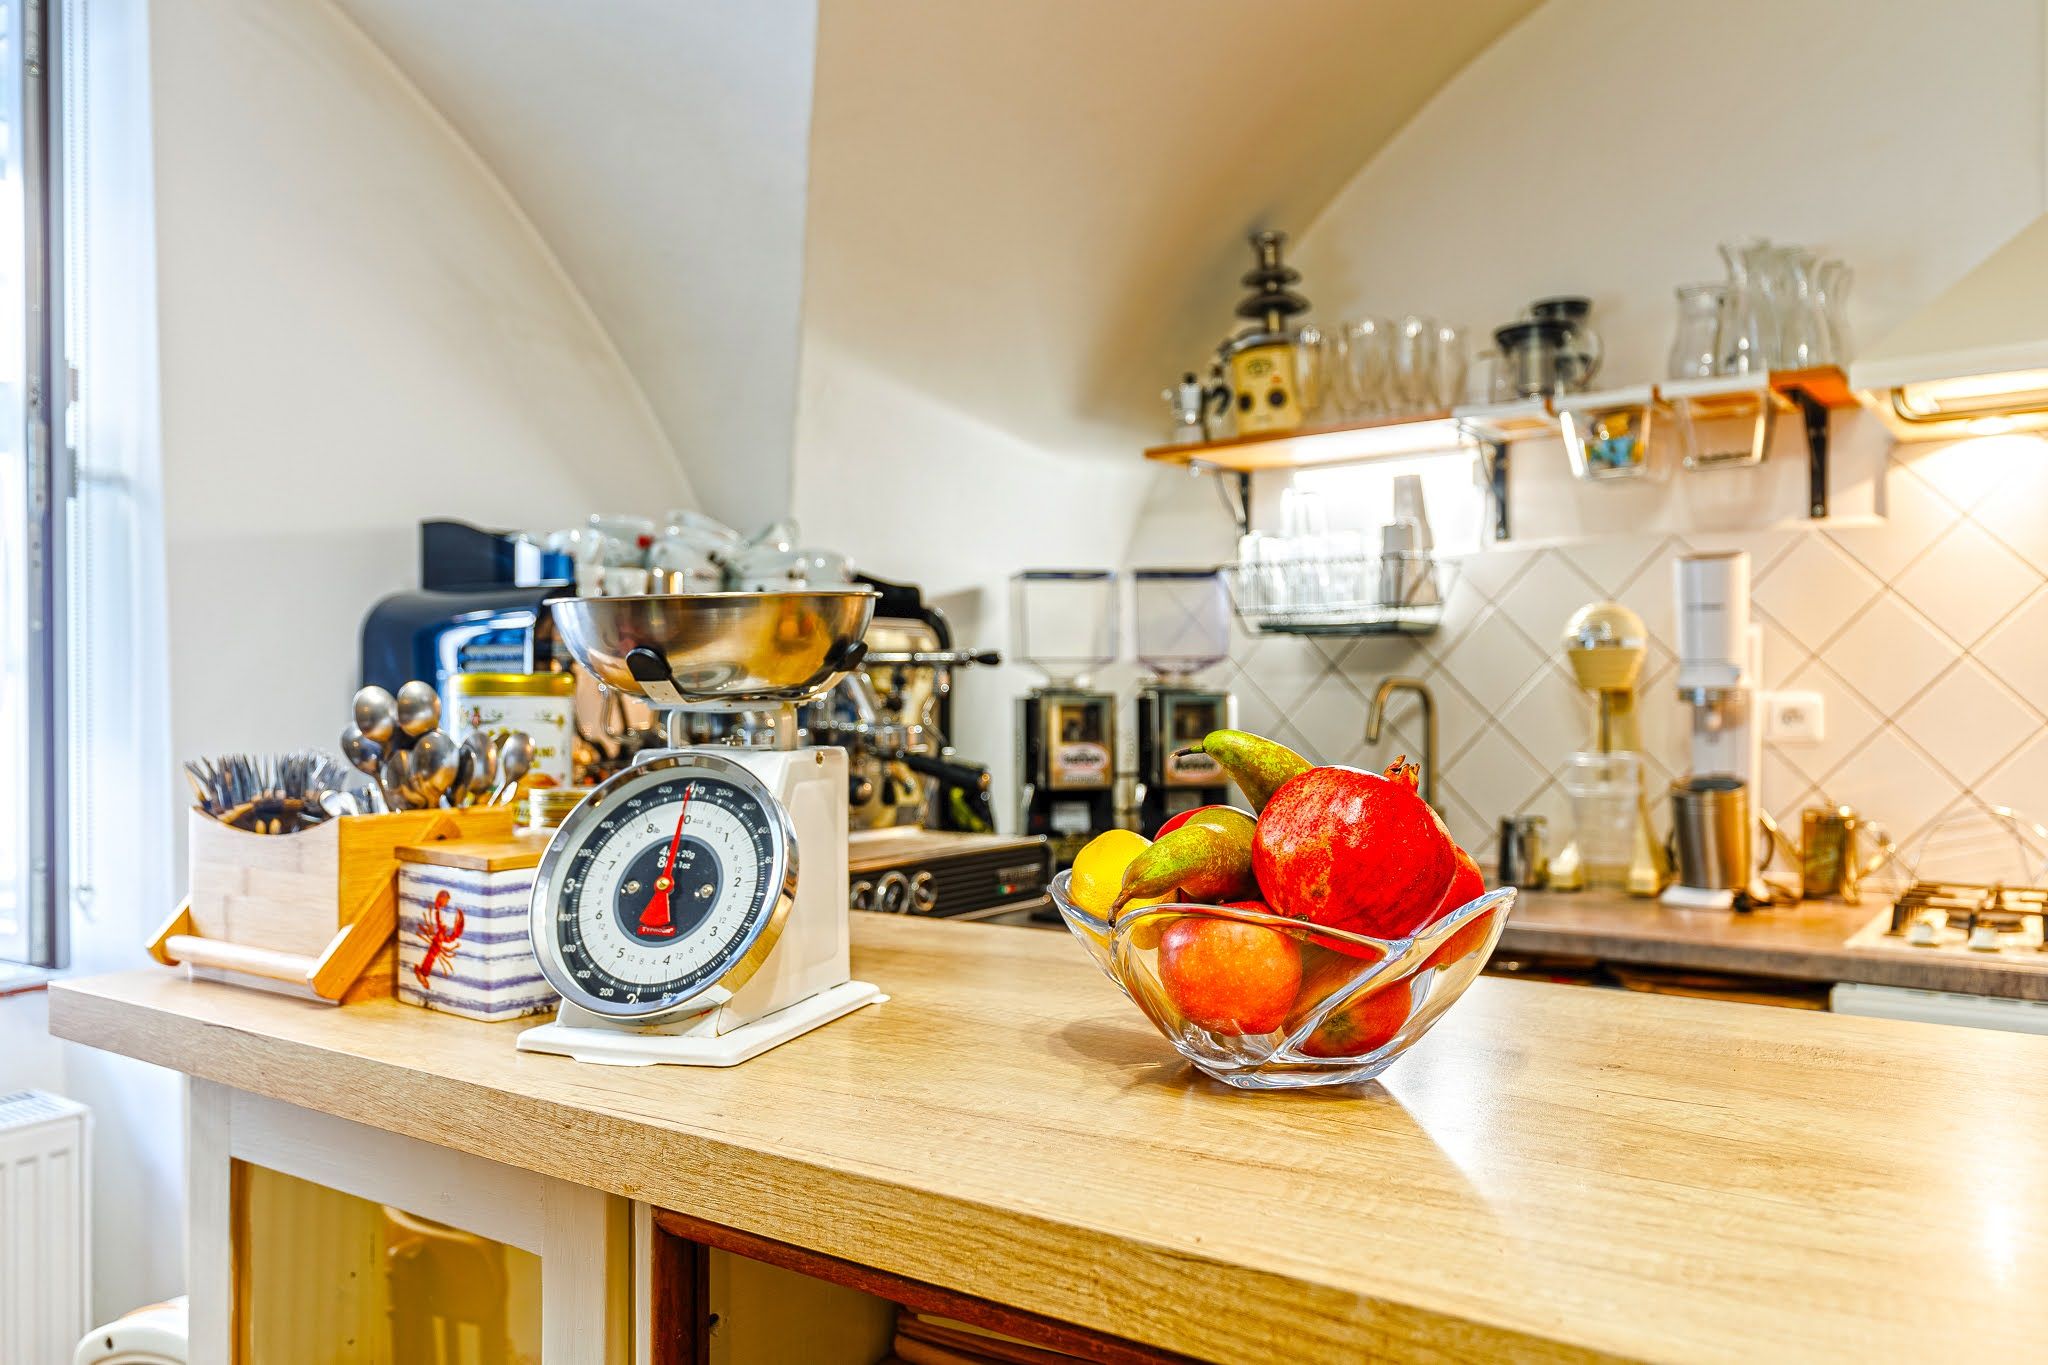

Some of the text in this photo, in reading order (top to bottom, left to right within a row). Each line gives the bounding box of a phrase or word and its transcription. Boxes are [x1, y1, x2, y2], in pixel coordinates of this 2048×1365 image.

[716, 788, 734, 797] 200g
[741, 802, 757, 811] 400
[684, 815, 691, 825] 0
[724, 832, 729, 843] 1
[764, 855, 774, 864] 80
[608, 860, 616, 871] 7
[564, 878, 575, 894] 3
[733, 876, 742, 888] 2
[595, 909, 603, 920] 6
[709, 926, 718, 937] 3
[562, 944, 577, 953] 600
[616, 947, 626, 959] 5
[662, 954, 671, 966] 4
[577, 970, 591, 979] 400
[599, 987, 614, 996] 200
[662, 992, 678, 1001] 80
